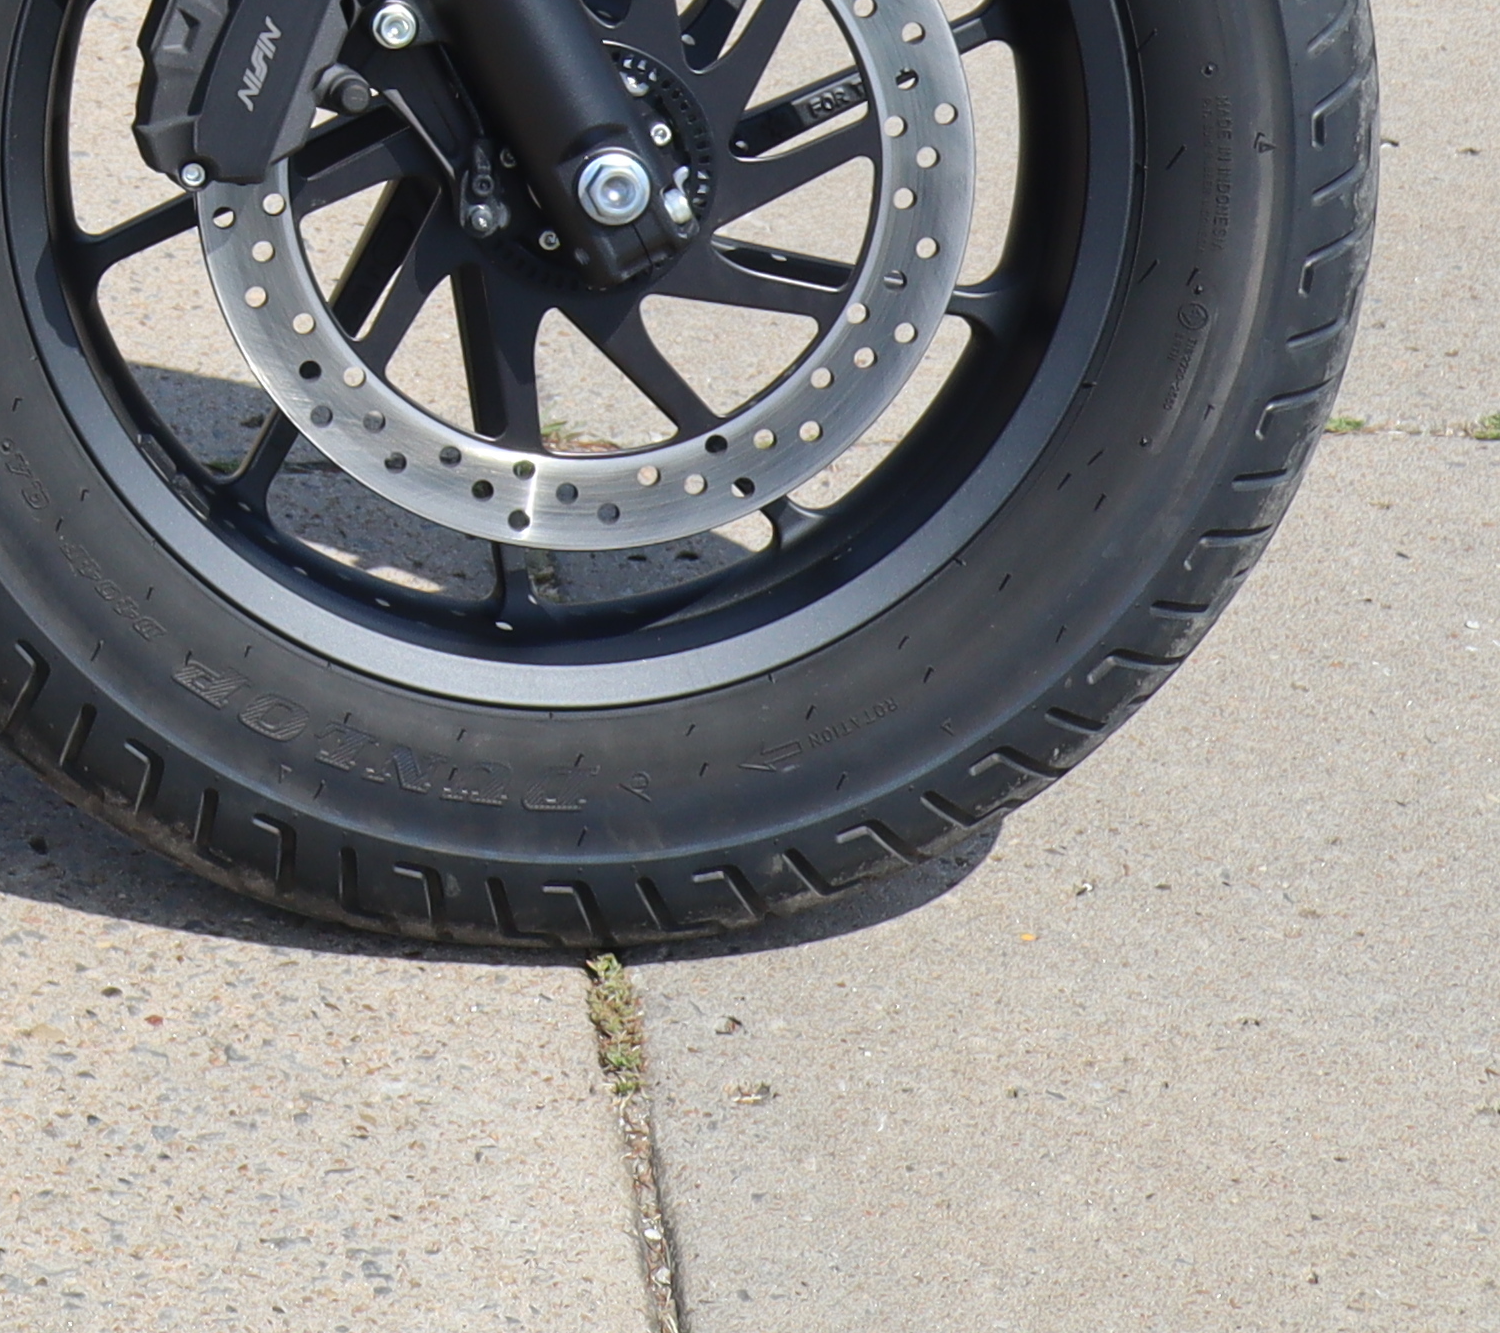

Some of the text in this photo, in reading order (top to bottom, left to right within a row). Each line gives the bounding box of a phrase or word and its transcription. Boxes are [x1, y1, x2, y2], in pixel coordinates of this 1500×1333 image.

[237, 14, 283, 113] NISIN
[806, 87, 850, 120] FOR
[1211, 94, 1234, 253] MADE IN INDONESIA
[173, 659, 598, 812] DUNLOP
[809, 695, 900, 749] ROTATION
